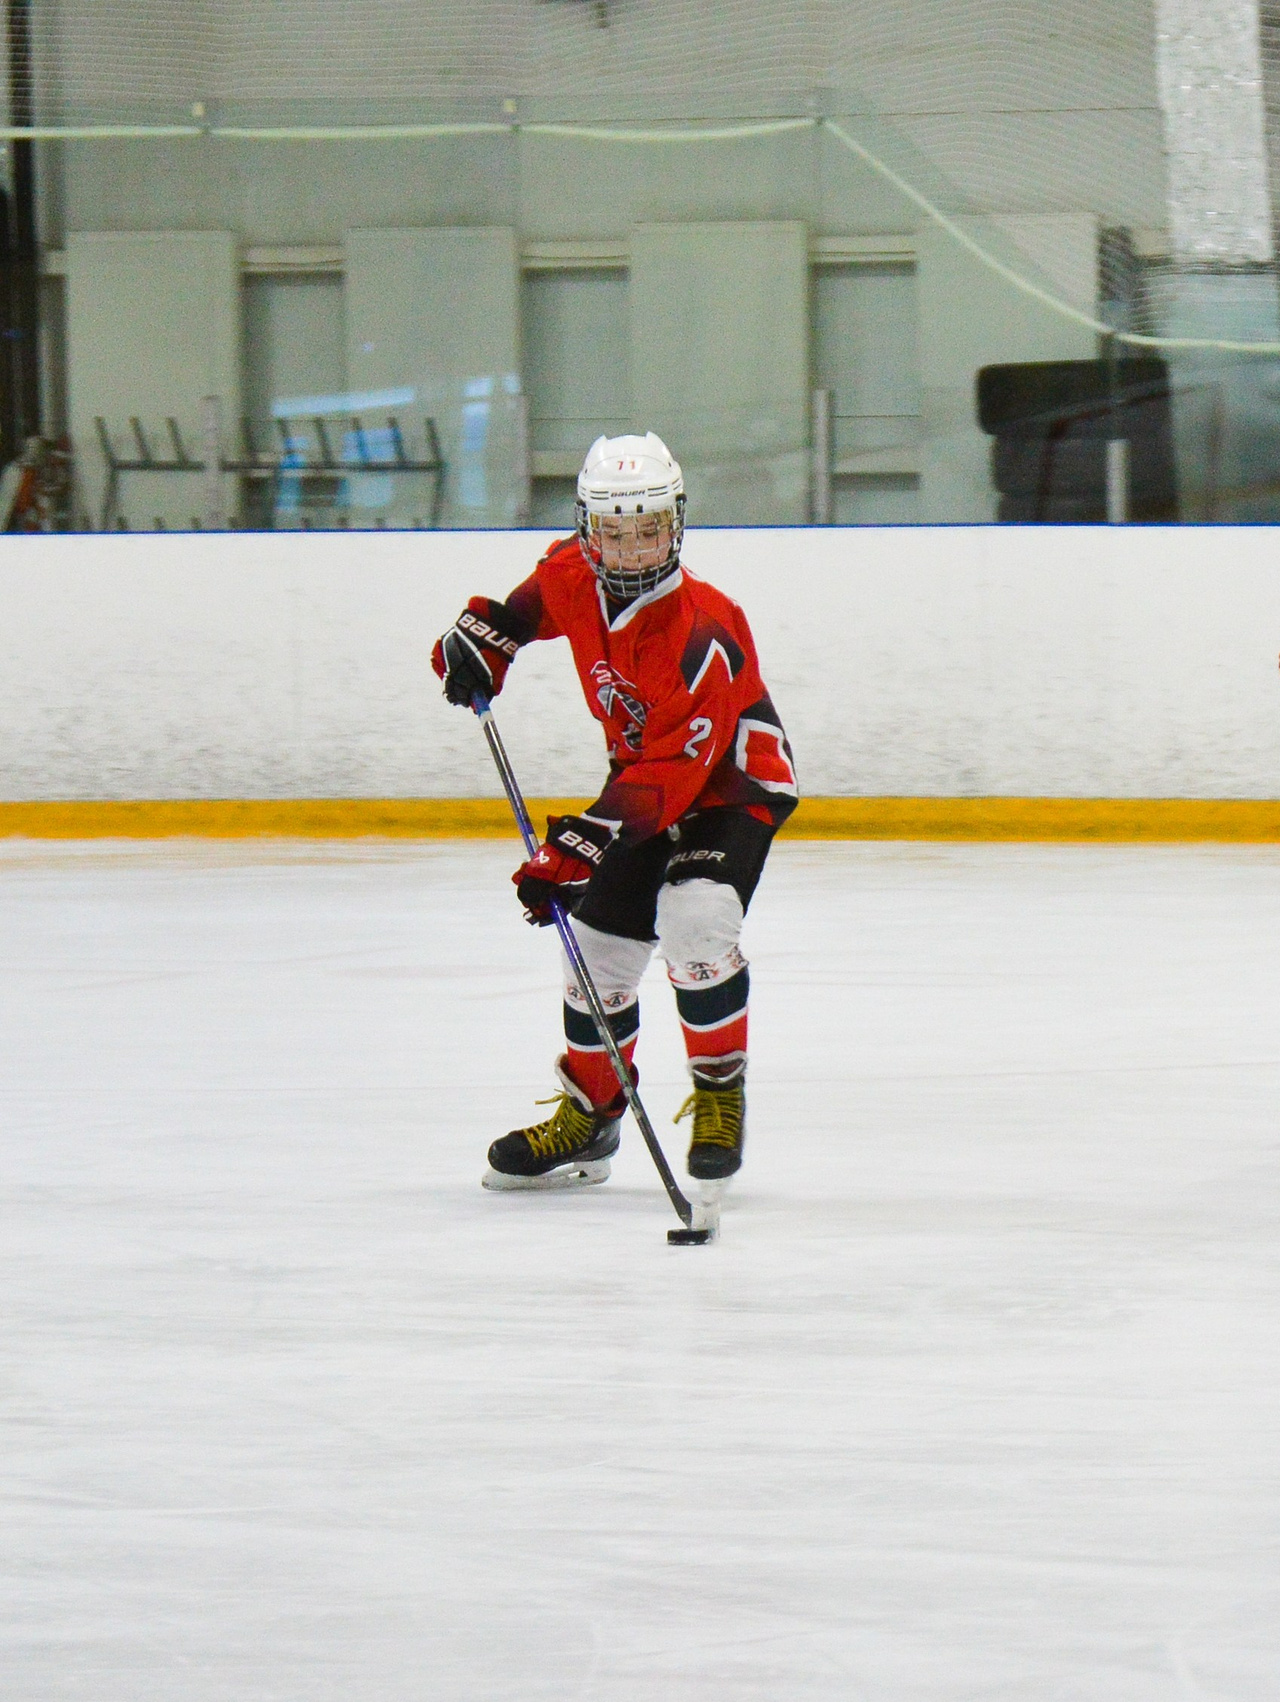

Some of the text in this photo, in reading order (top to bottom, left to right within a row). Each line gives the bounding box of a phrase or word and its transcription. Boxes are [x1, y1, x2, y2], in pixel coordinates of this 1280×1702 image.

[617, 460, 636, 471] 71
[458, 613, 519, 656] BAUE
[683, 716, 715, 765] 2
[558, 830, 604, 865] BAU
